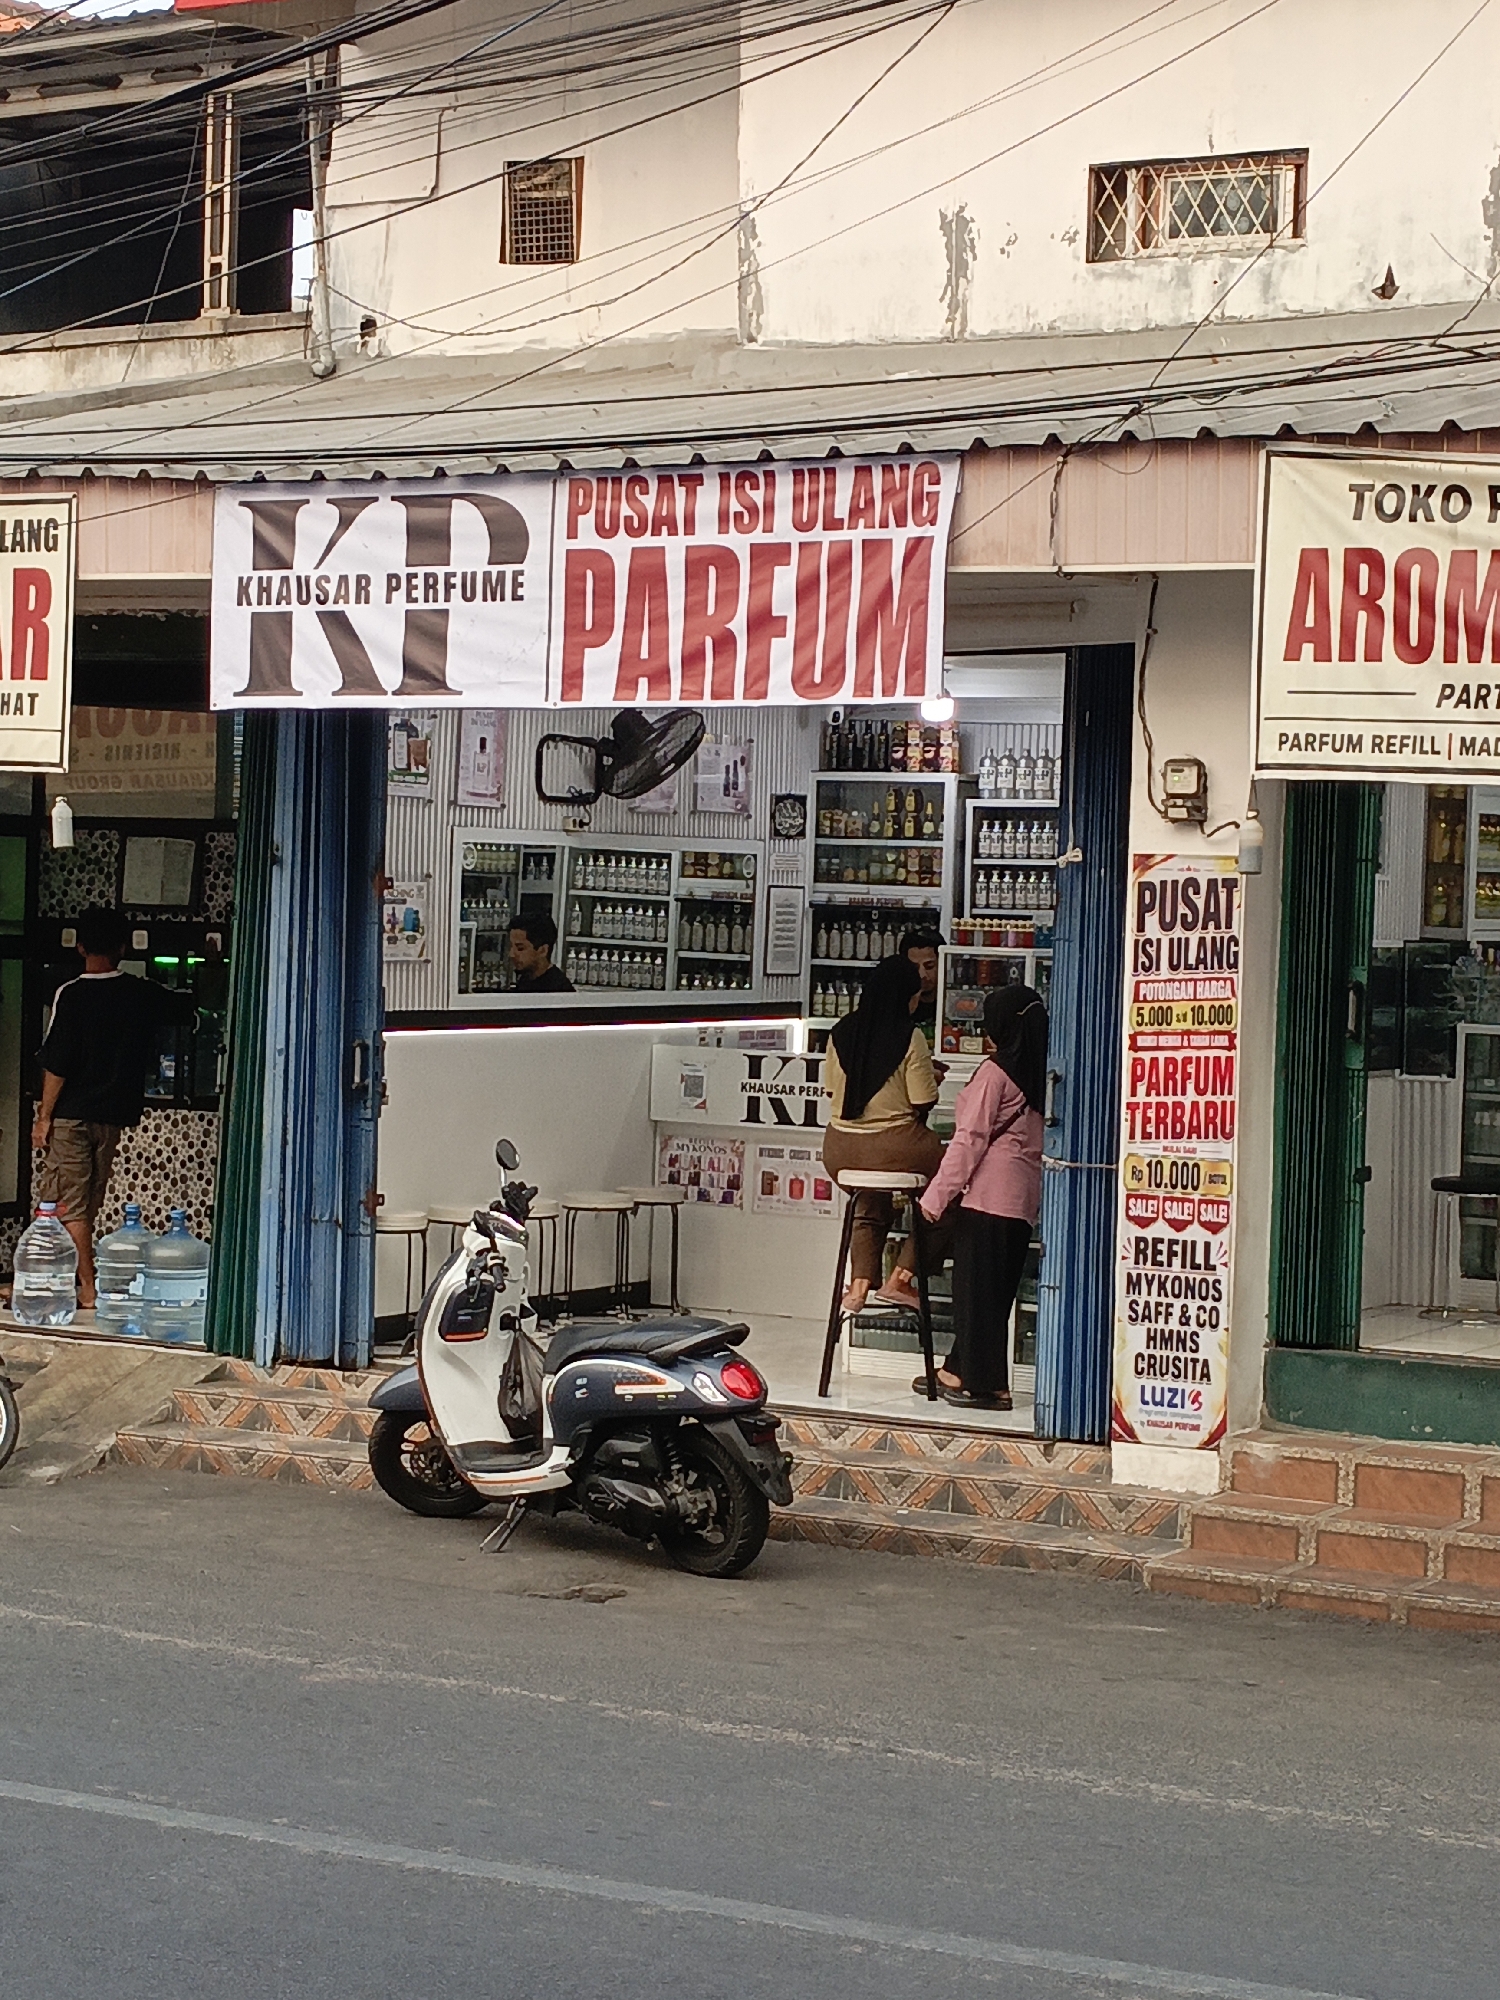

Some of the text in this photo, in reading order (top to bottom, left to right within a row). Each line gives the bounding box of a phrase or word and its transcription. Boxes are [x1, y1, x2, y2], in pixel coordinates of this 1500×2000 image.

[566, 461, 942, 539] PUSAT ISI ULANG
[1349, 483, 1472, 524] TOKO
[0, 518, 59, 553] LANG
[236, 569, 525, 607] KHAUSAR PERFUME
[560, 536, 935, 702] PARFUM
[1283, 547, 1500, 665] AROM
[0, 567, 52, 681] R
[1278, 732, 1363, 754] PARFUM
[1371, 734, 1441, 756] REFILL
[1136, 877, 1239, 933] PUSAT
[1132, 935, 1240, 973] ISI ULANG
[1139, 980, 1195, 1001] POTONGAN
[1136, 1005, 1173, 1027] 5.000
[1190, 1003, 1233, 1026] 10.000
[740, 1081, 826, 1098] KHAUSAR PERF
[1130, 1055, 1235, 1098] PARFUM
[1126, 1100, 1236, 1141] TERBARU
[1146, 1159, 1200, 1192] 10.000
[1128, 1198, 1228, 1224] SALE! SALE! SALE!
[1133, 1236, 1217, 1271] REFILL
[1126, 1272, 1222, 1302] MYKONOS
[1128, 1299, 1220, 1329] SAFF & CO
[1146, 1327, 1200, 1353] HMNS
[1134, 1352, 1212, 1382] CRUSITA
[1140, 1384, 1186, 1409] LUZI
